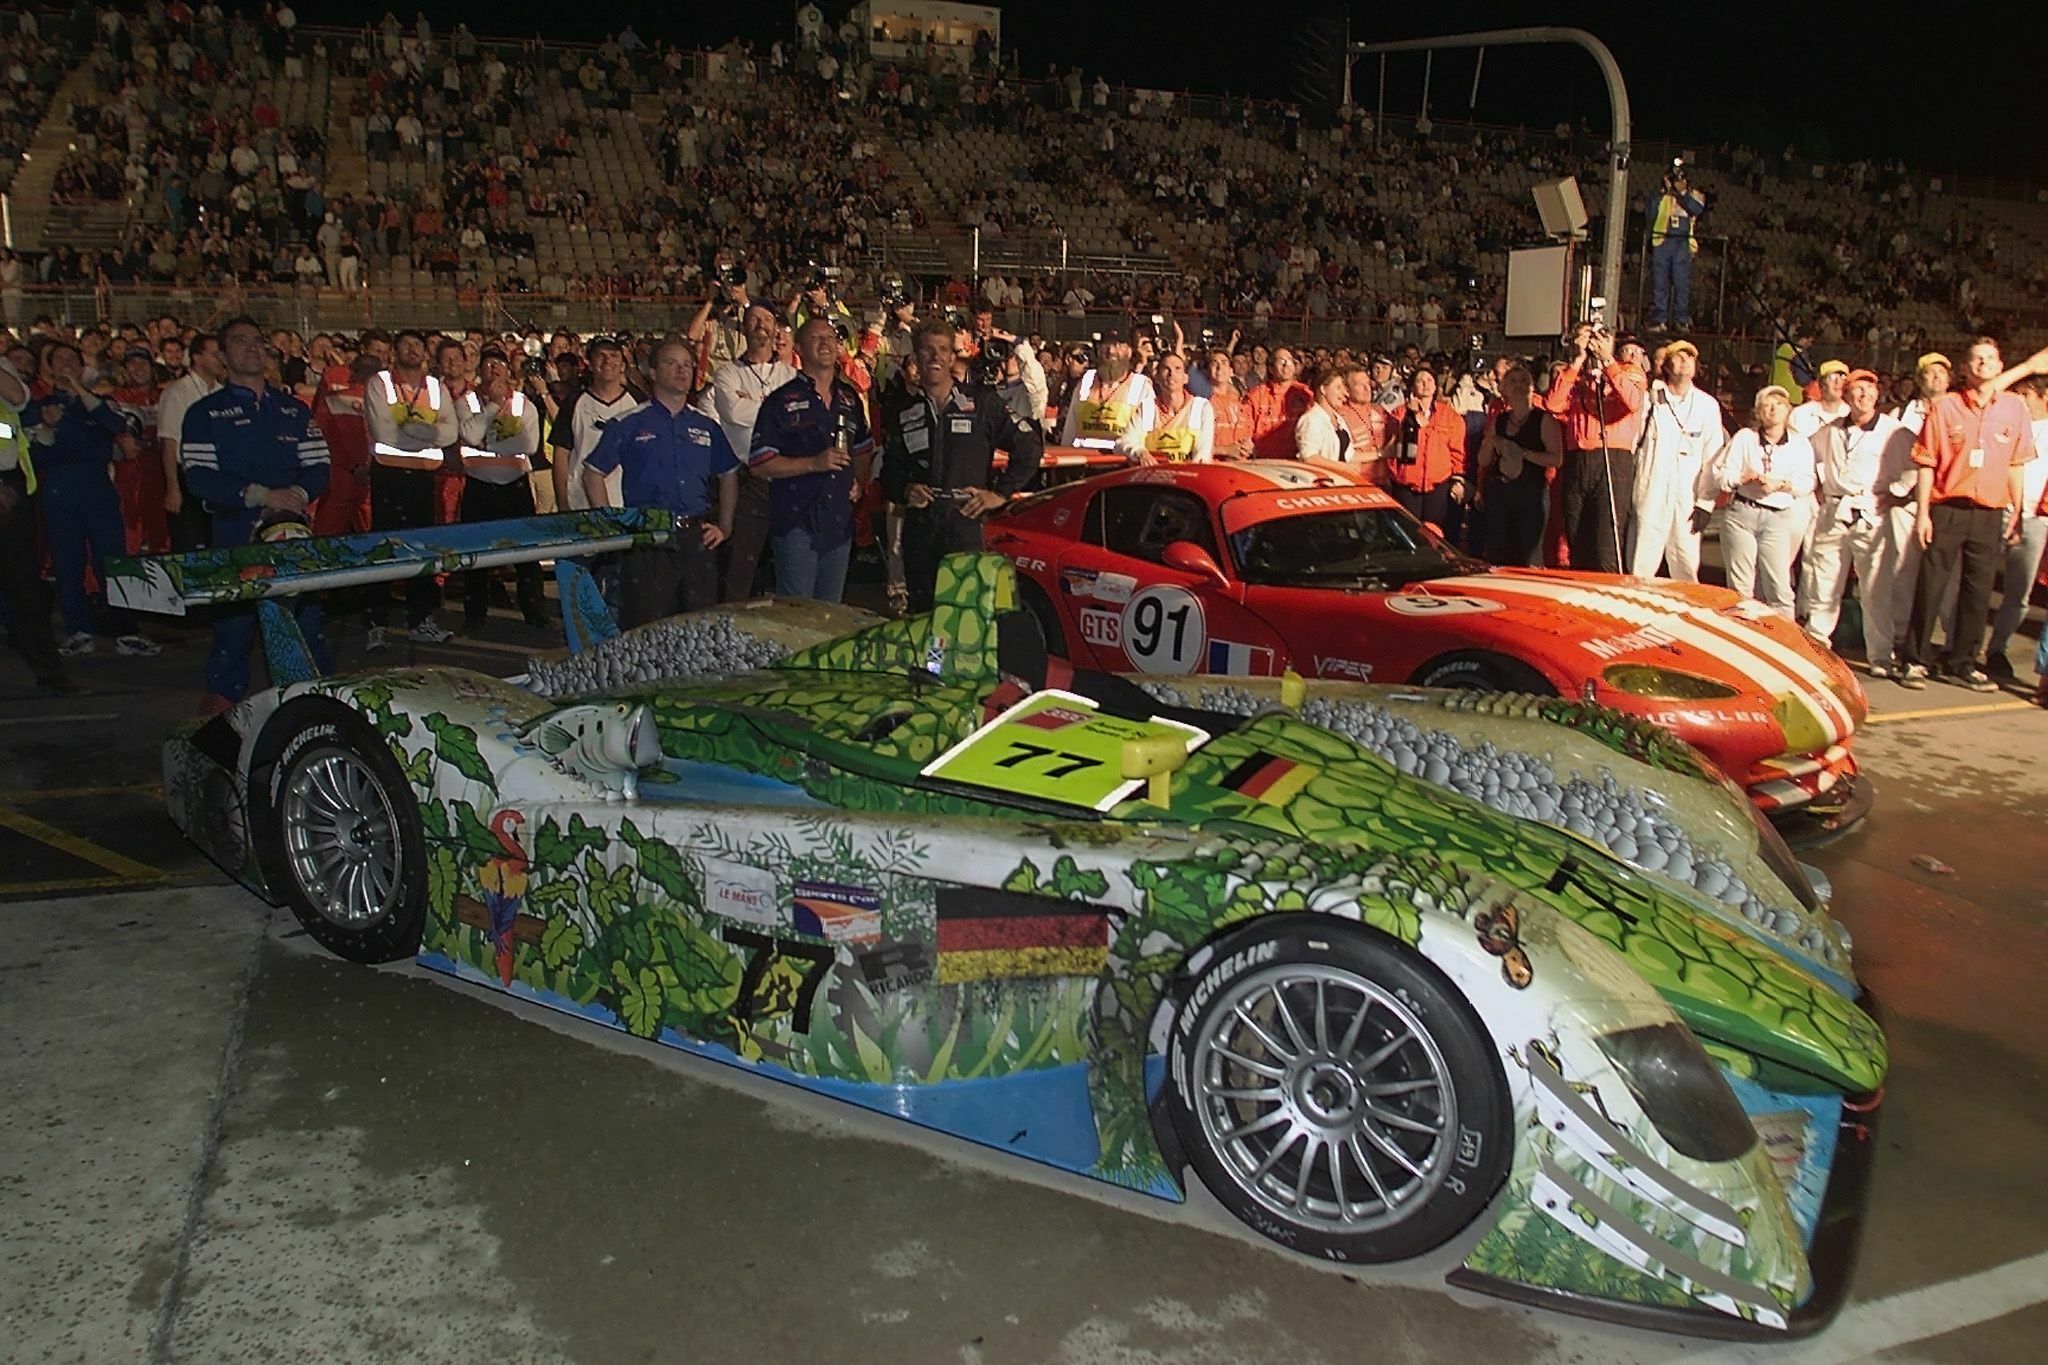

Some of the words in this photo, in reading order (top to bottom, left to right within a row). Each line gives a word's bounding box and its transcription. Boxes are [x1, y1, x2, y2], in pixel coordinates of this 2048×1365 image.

[1082, 613, 1119, 642] GTS
[1132, 596, 1191, 662] 91
[1313, 654, 1374, 684] VIPER
[993, 741, 1105, 779] 77
[722, 924, 836, 1035] 77
[869, 970, 934, 995] RICARDO
[1179, 939, 1279, 1038] MICHELIN
